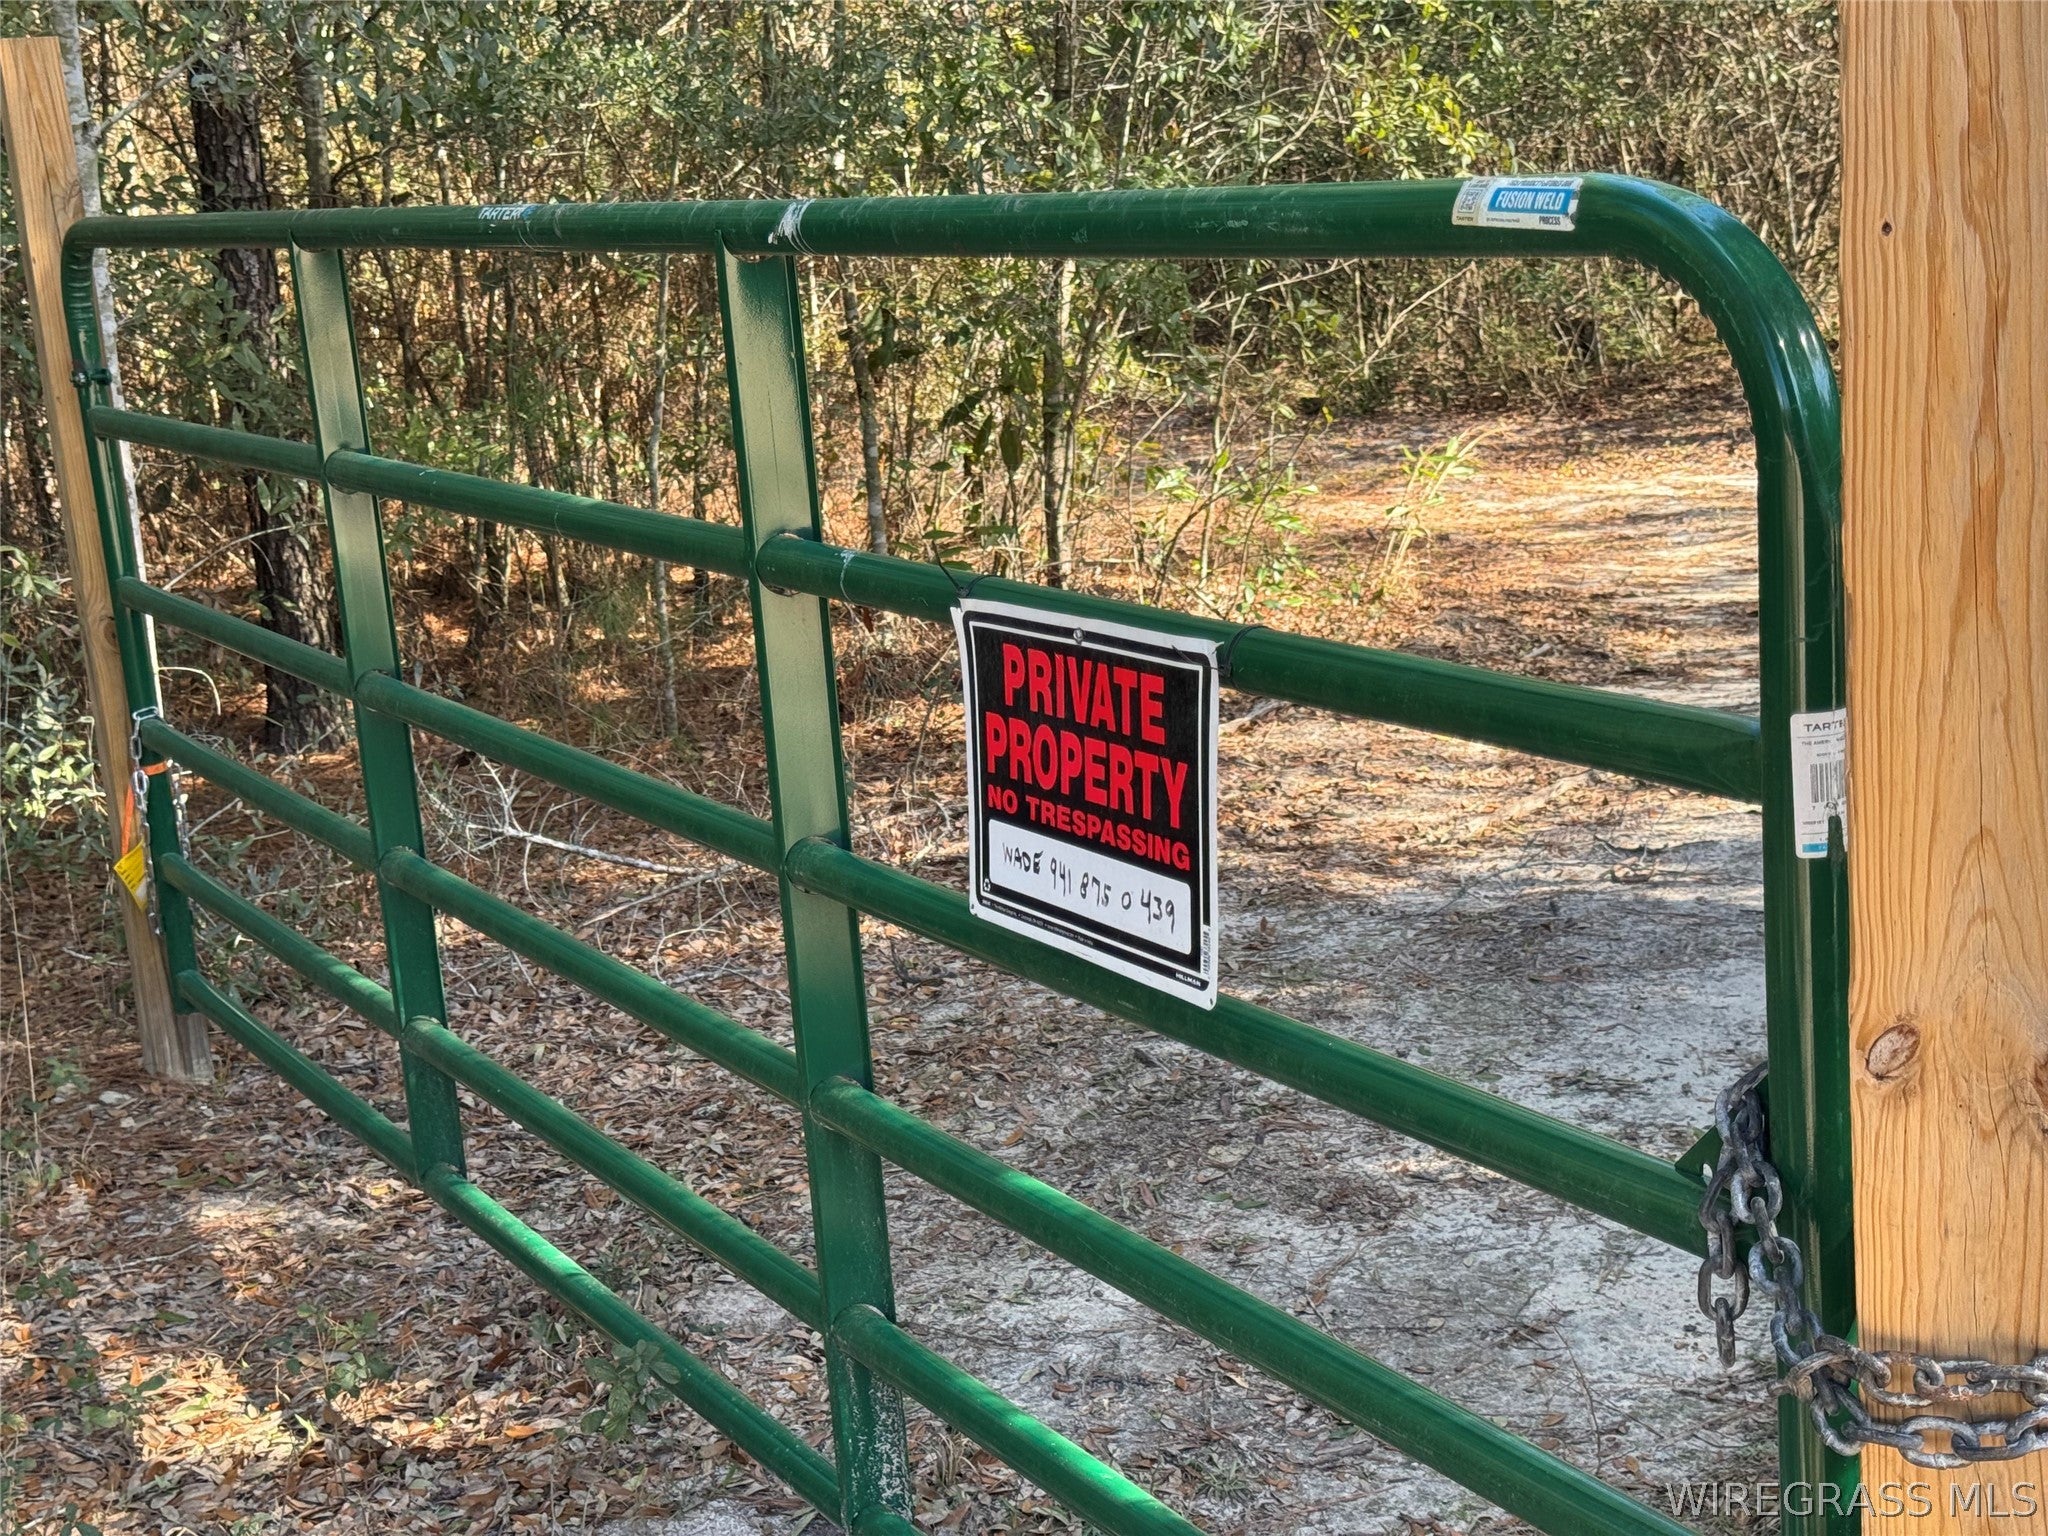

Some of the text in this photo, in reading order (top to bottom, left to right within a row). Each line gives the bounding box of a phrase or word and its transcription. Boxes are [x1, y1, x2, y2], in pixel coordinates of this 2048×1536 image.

[1495, 190, 1566, 211] FUSION WELD
[1538, 215, 1562, 226] PROCESS
[1002, 642, 1166, 746] PRIVATE
[1803, 719, 1846, 732] TARTE
[985, 711, 1188, 829] PROPERTY
[987, 784, 1191, 872] NO TRESPASSING
[1002, 843, 1176, 935] WADE 941 875 0 439
